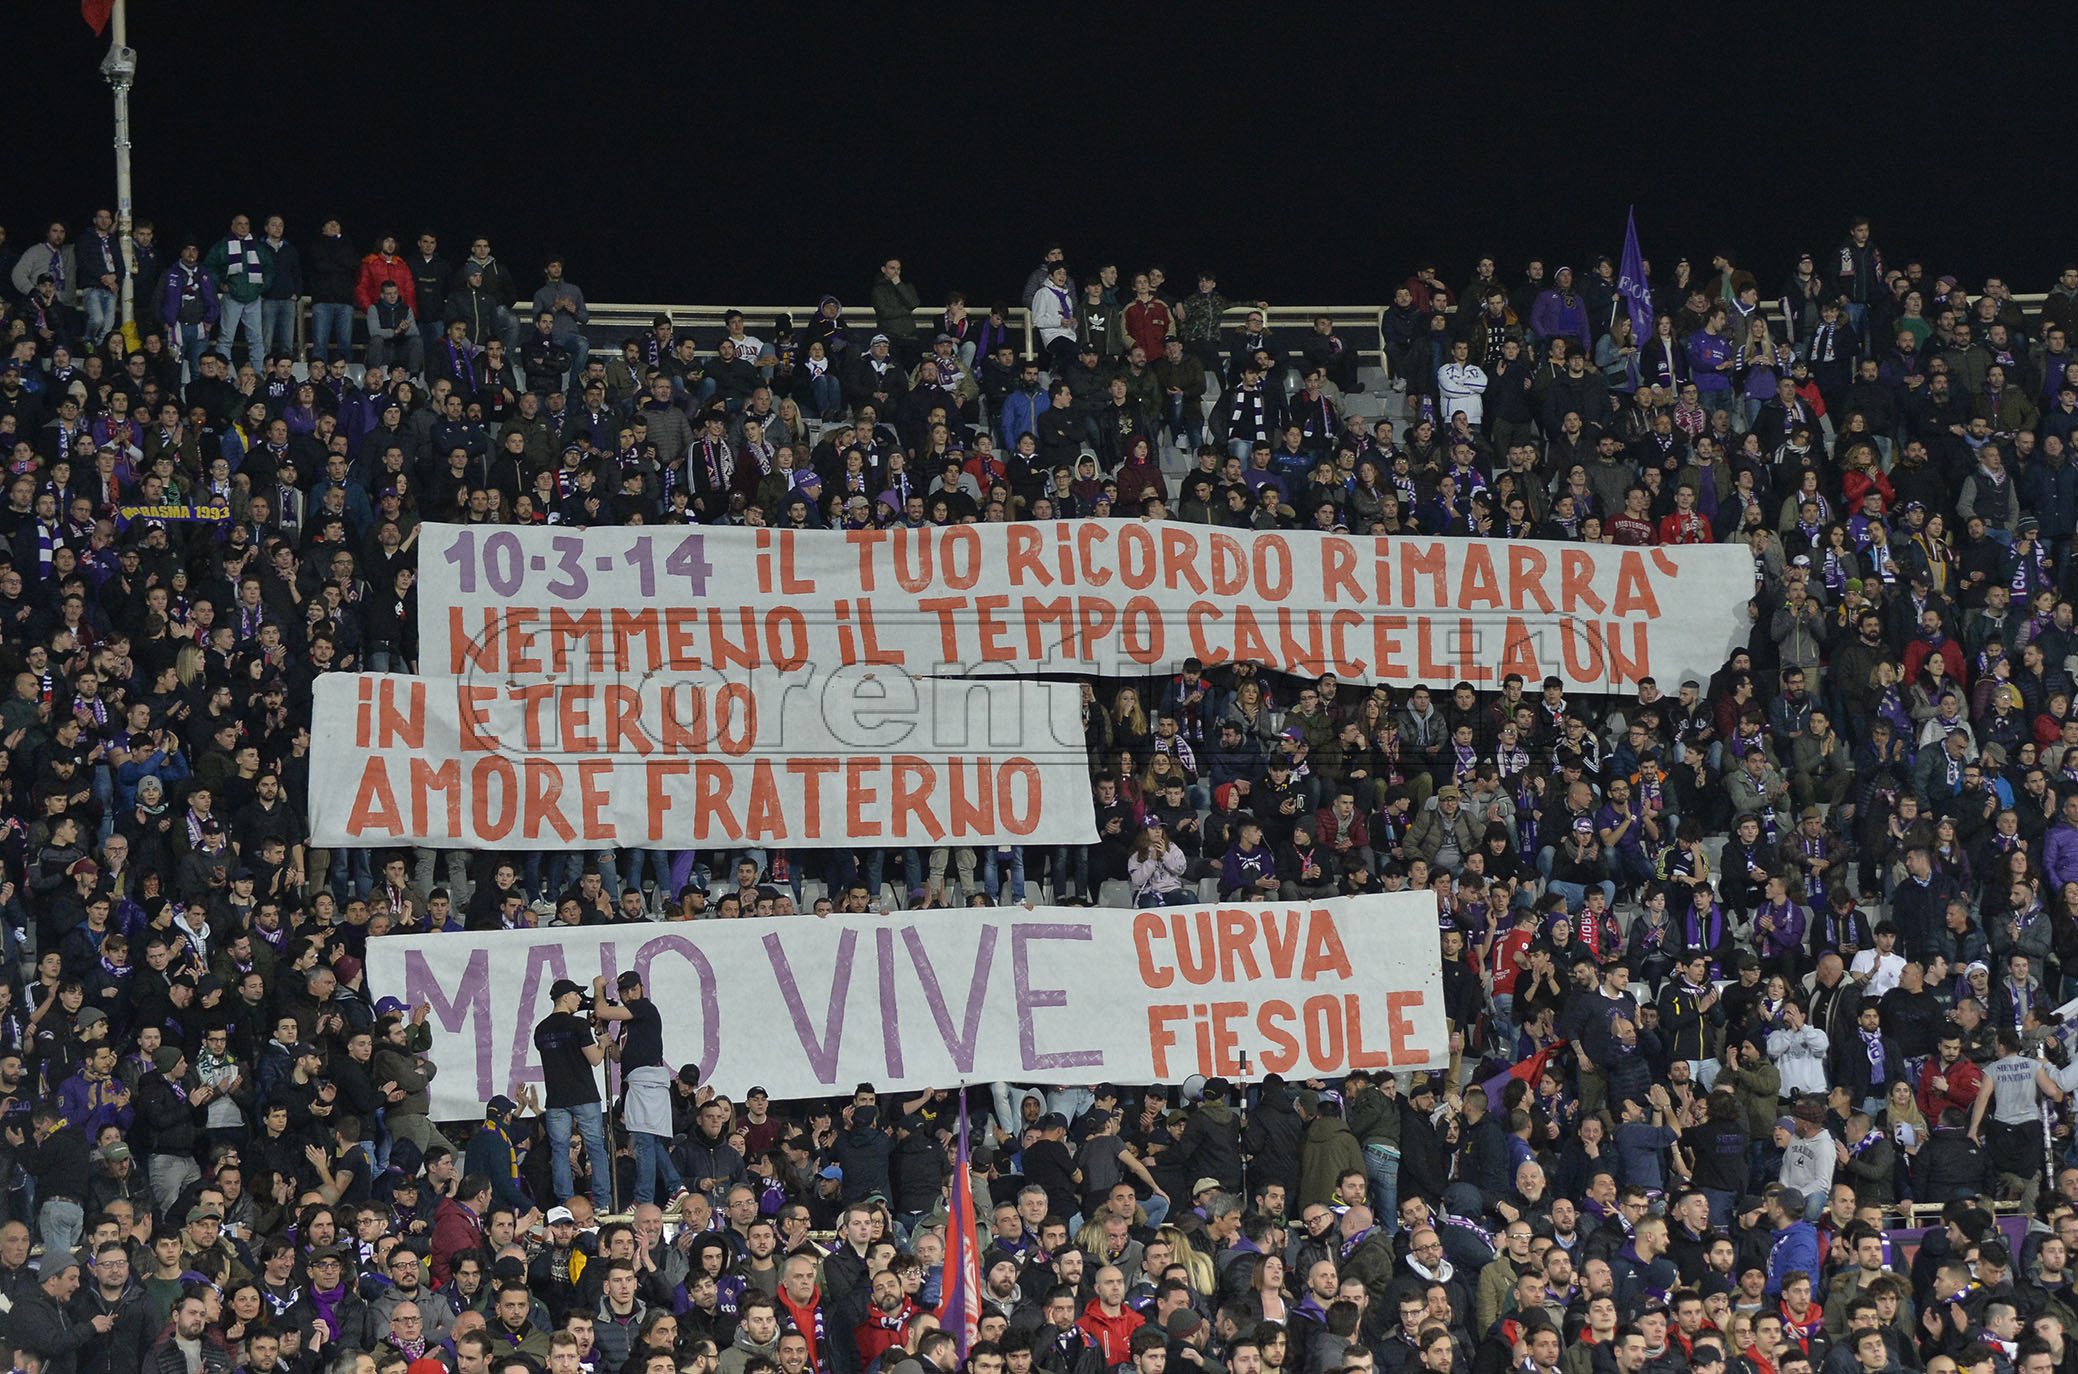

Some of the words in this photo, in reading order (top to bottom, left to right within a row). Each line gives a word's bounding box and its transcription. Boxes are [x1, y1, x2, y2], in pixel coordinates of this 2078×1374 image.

[194, 505, 231, 520] 1993
[846, 525, 981, 593] TUO
[449, 606, 809, 674] NEMMENO
[918, 595, 1164, 664] TEMPO
[1187, 601, 1541, 683] CANCELLA
[1560, 619, 1649, 684] UN
[459, 682, 757, 757] ETERNO
[346, 755, 617, 843] AMORE
[646, 755, 1042, 843] FRATERNO
[1133, 909, 1353, 989] CURVA
[761, 923, 1104, 1084] VIVE
